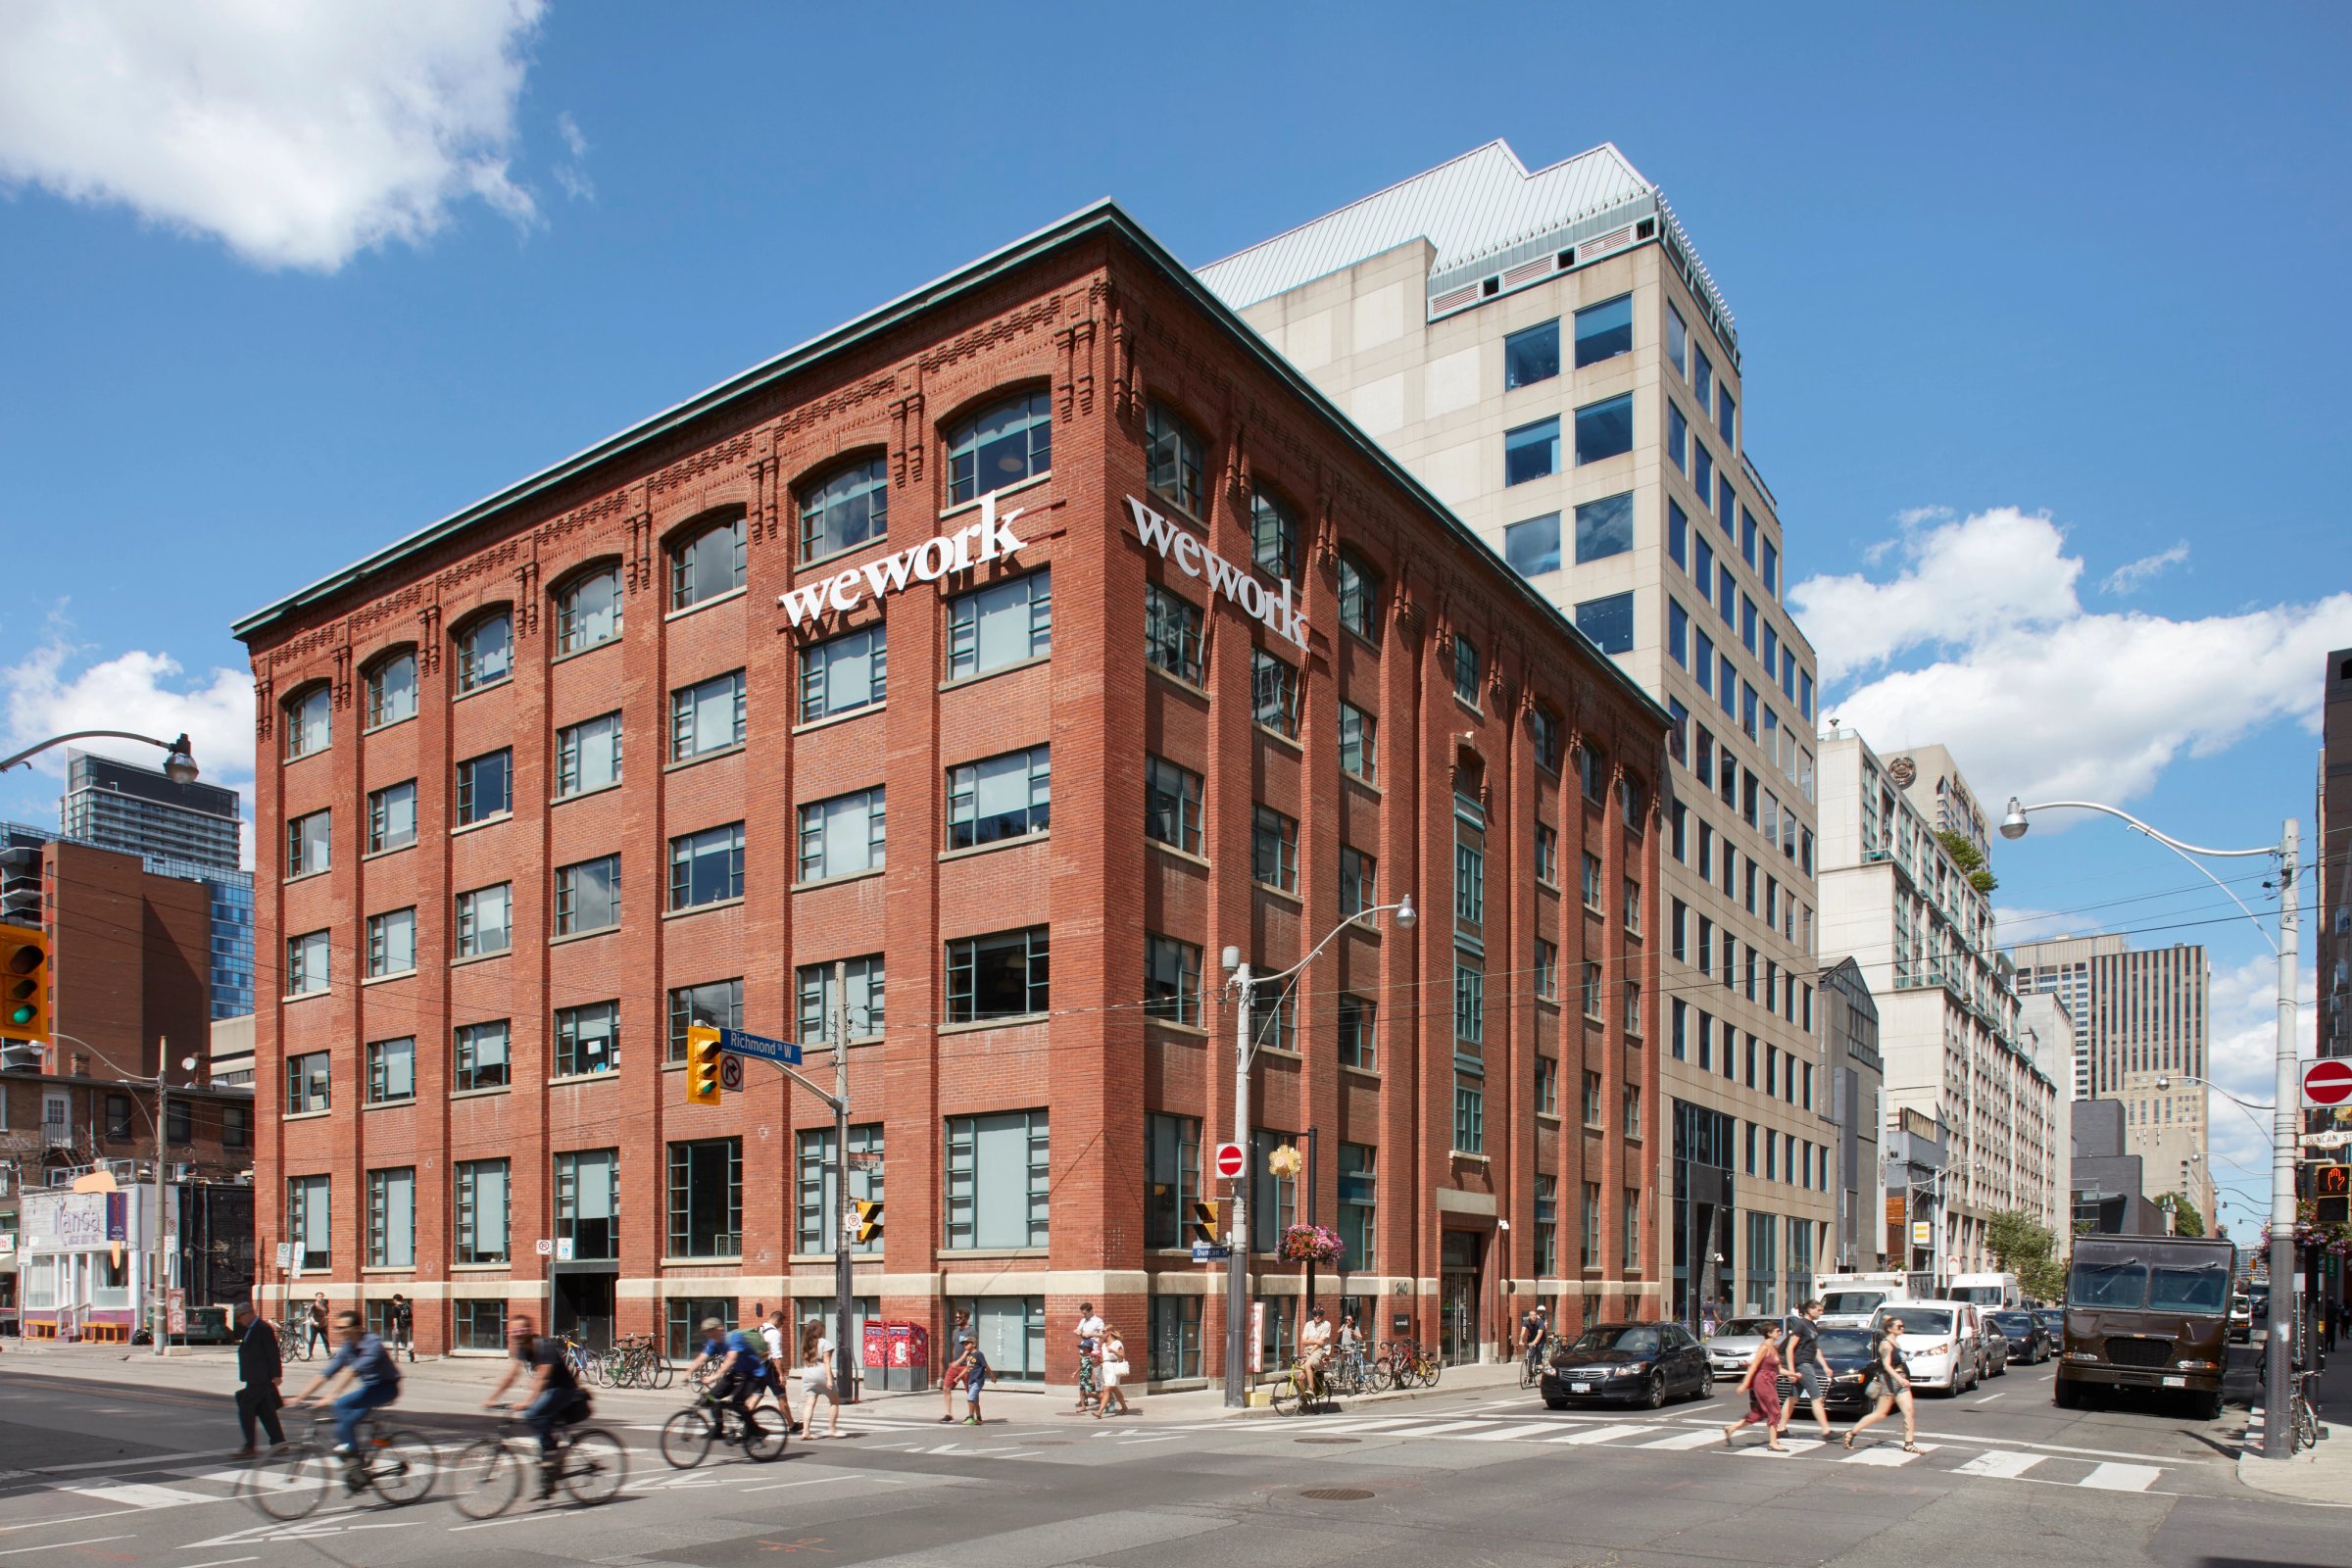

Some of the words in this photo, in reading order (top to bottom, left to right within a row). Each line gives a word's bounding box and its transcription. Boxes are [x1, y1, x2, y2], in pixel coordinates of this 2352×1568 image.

[778, 489, 1028, 628] wework
[1126, 493, 1311, 653] wework
[730, 1032, 776, 1055] Richmond
[777, 1043, 783, 1052] St
[784, 1045, 792, 1058] W
[2306, 1134, 2337, 1144] DUNCAN
[1249, 1312, 1260, 1368] PARK
